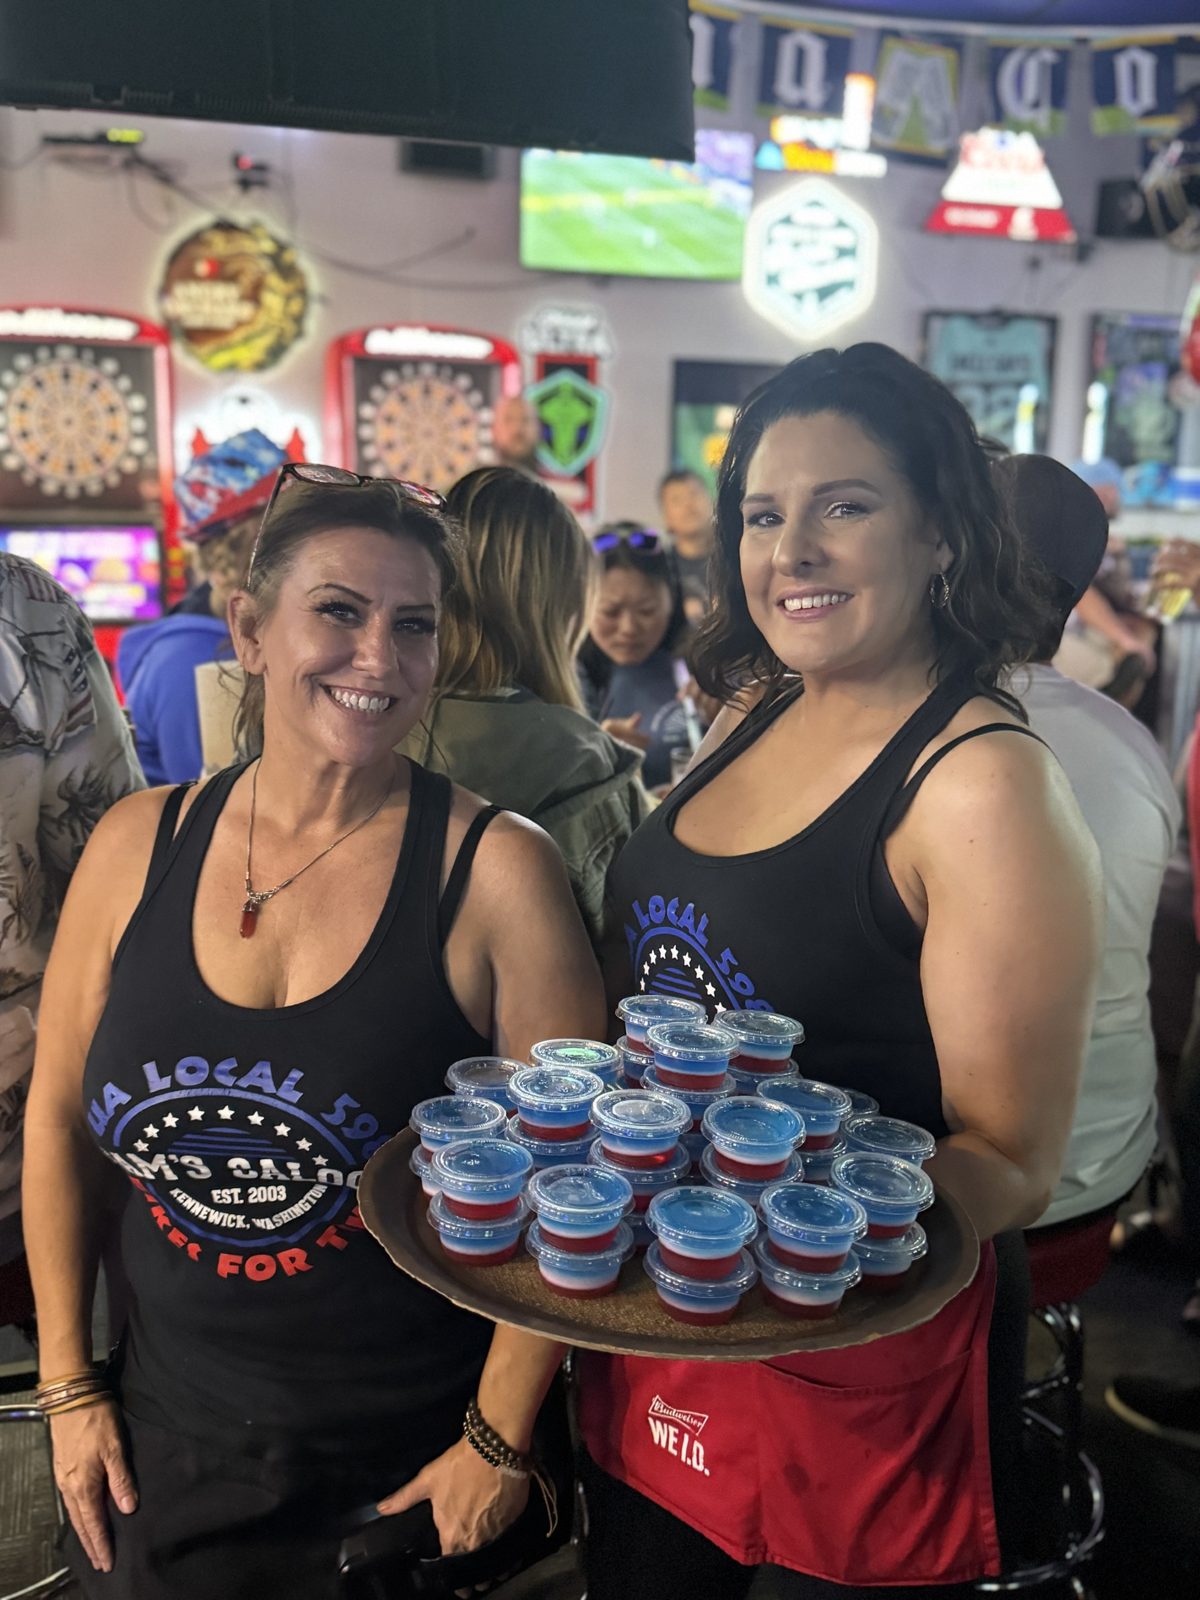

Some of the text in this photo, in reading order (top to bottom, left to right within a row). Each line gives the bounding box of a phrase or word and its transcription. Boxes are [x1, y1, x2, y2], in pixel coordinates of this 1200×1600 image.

[632, 894, 709, 949] LOCAL
[142, 1055, 304, 1104] LOCAL
[169, 1184, 329, 1231] KENNEWICK, WASHINGTON
[211, 1185, 287, 1205] EST. 2003
[216, 1247, 314, 1282] FOR
[653, 1400, 703, 1429] Budweiser
[647, 1416, 680, 1457] WE
